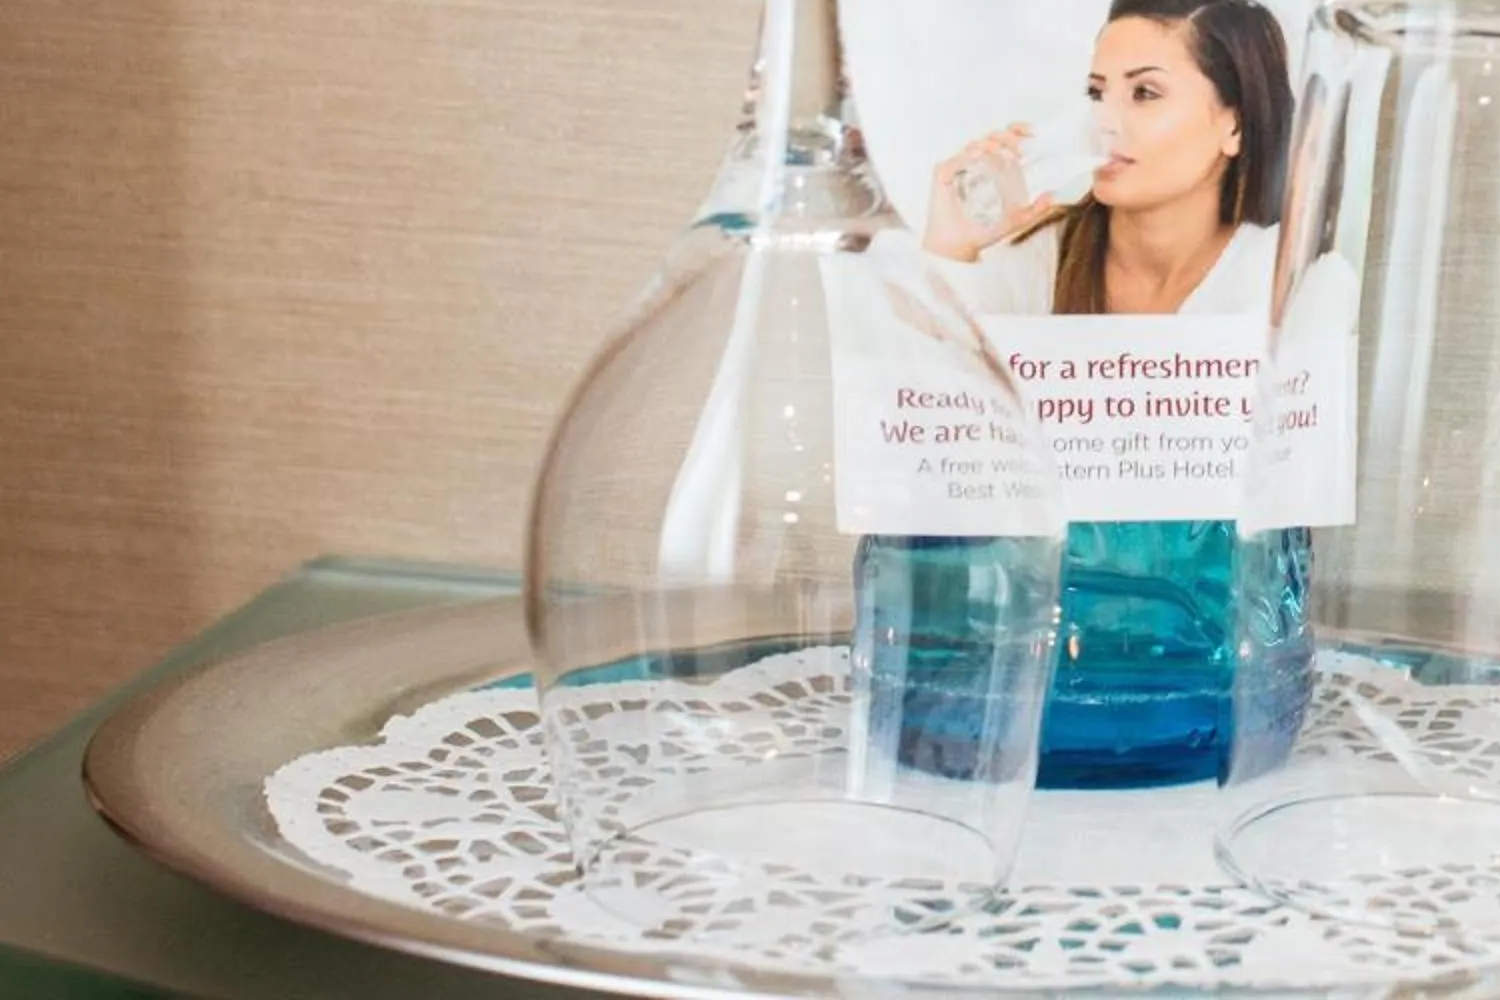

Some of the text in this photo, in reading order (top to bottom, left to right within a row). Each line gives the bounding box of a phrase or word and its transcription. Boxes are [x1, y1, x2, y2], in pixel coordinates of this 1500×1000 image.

[896, 388, 986, 415] Ready
[1009, 353, 1052, 380] for
[1060, 359, 1077, 380] a
[879, 420, 926, 444] We
[935, 423, 982, 444] are
[1104, 396, 1136, 418] to
[1145, 391, 1231, 418] invite
[917, 457, 933, 474] A
[1111, 433, 1151, 454] gift
[1159, 433, 1214, 451] from
[948, 481, 996, 499] Best
[1118, 460, 1166, 479] Plus
